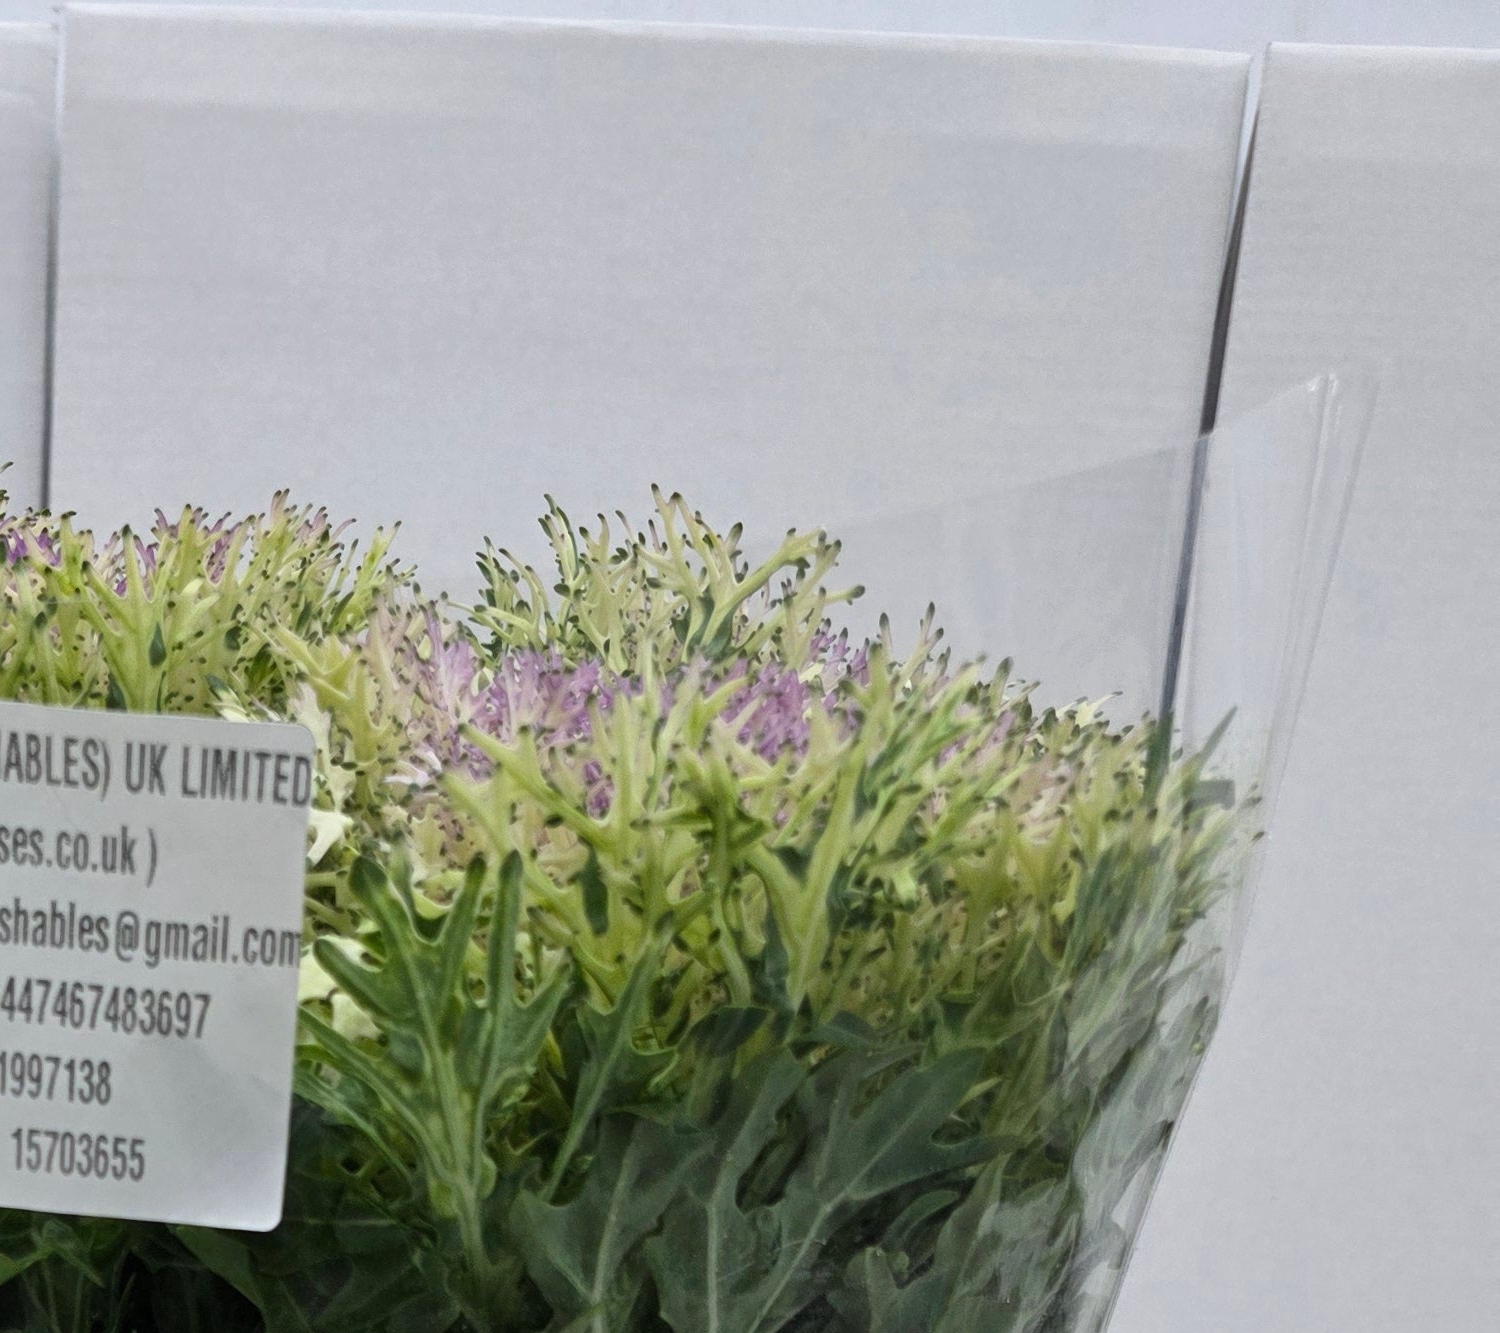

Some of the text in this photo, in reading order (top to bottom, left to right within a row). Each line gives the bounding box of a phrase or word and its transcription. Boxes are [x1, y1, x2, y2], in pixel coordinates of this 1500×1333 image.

[125, 744, 166, 795] UK
[182, 747, 313, 807] LIMITED
[11, 1128, 145, 1183] 15703655
